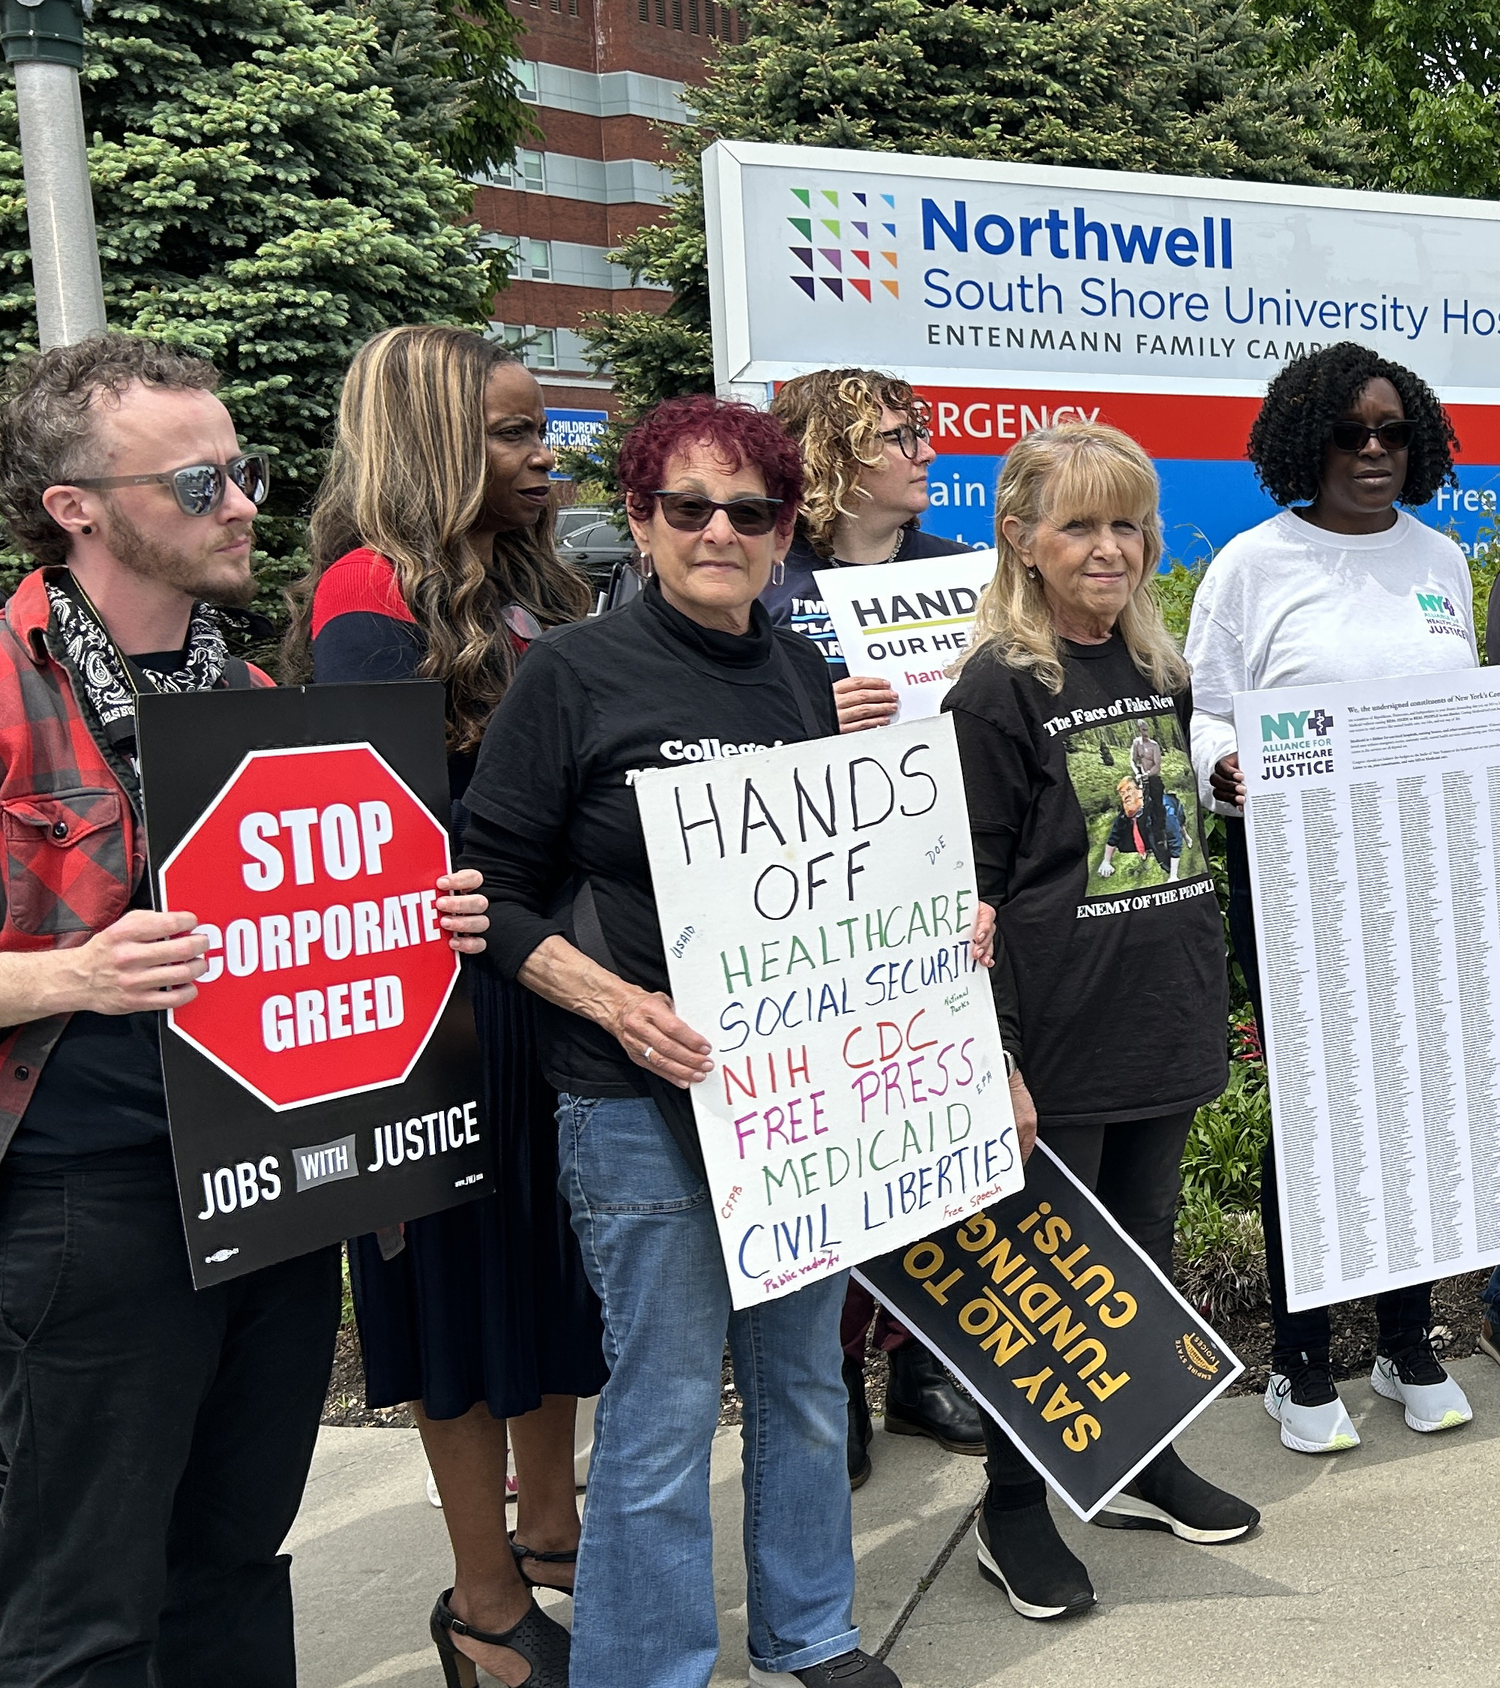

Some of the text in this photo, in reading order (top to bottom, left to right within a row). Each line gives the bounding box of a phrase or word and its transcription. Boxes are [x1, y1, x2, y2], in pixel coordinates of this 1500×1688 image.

[921, 199, 1232, 269] Northwell
[925, 269, 1063, 313] South
[1081, 282, 1208, 322] Shore
[1226, 286, 1428, 339] University
[928, 325, 1331, 360] ENTENMANN FAMILY CAMP
[552, 420, 605, 434] CHILDREN'S
[914, 401, 1100, 438] ERGENCY
[930, 473, 985, 506] ain
[1436, 484, 1496, 511] Free
[851, 584, 990, 627] HAND
[1416, 593, 1444, 613] NY
[867, 637, 925, 661] OUR
[1043, 694, 1174, 737] The Face of Fake New
[1261, 710, 1310, 741] NY
[1262, 737, 1332, 753] ALLIANCE FOR
[1263, 749, 1333, 764] HEALTHCARE
[1261, 760, 1334, 780] JUSTICE
[674, 744, 938, 865] HANDS
[239, 800, 394, 892] STOP
[925, 835, 947, 866] DOE
[755, 841, 871, 920] OFF
[1076, 898, 1132, 919] ENEMY
[1133, 893, 1150, 911] OF
[1149, 889, 1178, 907] THE
[195, 889, 441, 984] CORPORATE
[721, 890, 973, 994] HEALTHCARE
[262, 975, 405, 1053] GREED
[720, 976, 855, 1052] SOCIAL
[723, 1008, 938, 1105] NIH CDC
[734, 1037, 974, 1159] FREE PRESS
[976, 1070, 993, 1095] EPA
[198, 1100, 480, 1221] JOBS WITH JUSTICE
[762, 1103, 971, 1206] MEDICAID
[737, 1127, 1015, 1279] CIVIL LIBERTIES
[943, 1204, 964, 1221] Free
[1016, 1201, 1138, 1329] CUTS!
[955, 1211, 1132, 1402] FUNDING
[902, 1241, 1102, 1452] SAY NO TO
[1175, 1340, 1187, 1363] STATE
[1194, 1337, 1216, 1362] VOICES
